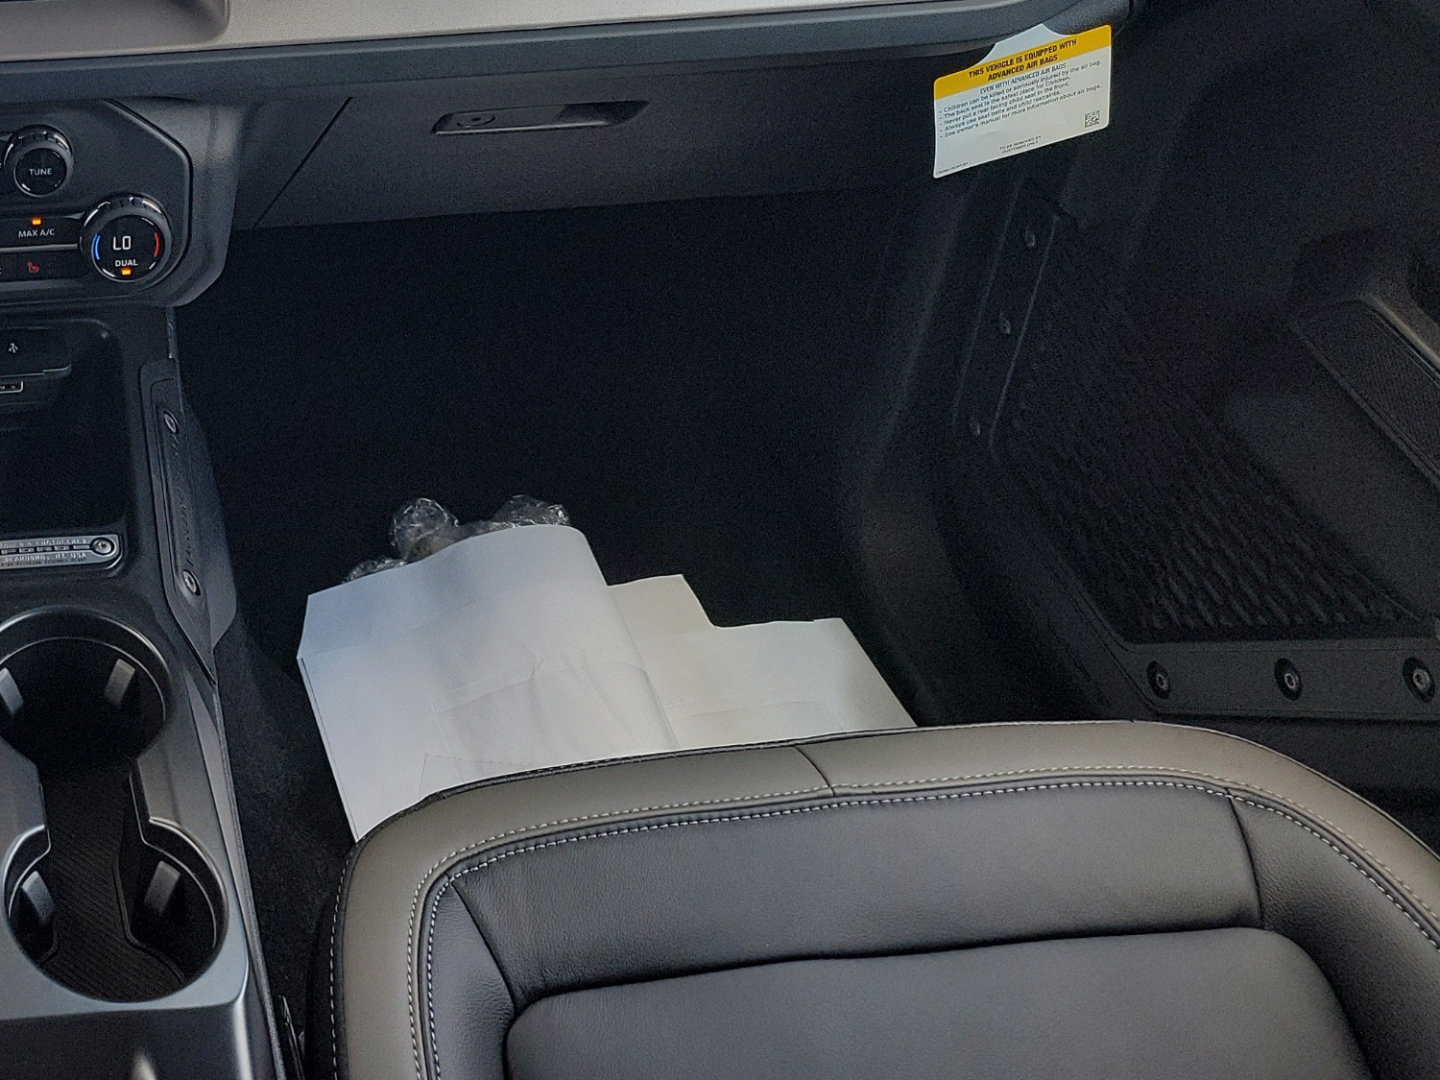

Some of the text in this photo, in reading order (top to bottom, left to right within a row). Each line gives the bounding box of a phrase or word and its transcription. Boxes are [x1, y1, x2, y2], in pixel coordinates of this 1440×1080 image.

[968, 38, 1077, 78] THIS VEHICLE IS EQUIPPED WITH
[988, 52, 1058, 81] ADVANCED AIR BAGS
[980, 84, 994, 94] EVEN
[994, 79, 1010, 89] WITH
[1010, 70, 1040, 84] ADVANCED
[28, 168, 52, 176] TUNE
[18, 228, 55, 238] MAX A/C
[113, 235, 132, 250] LO
[114, 258, 138, 267] DUAL
